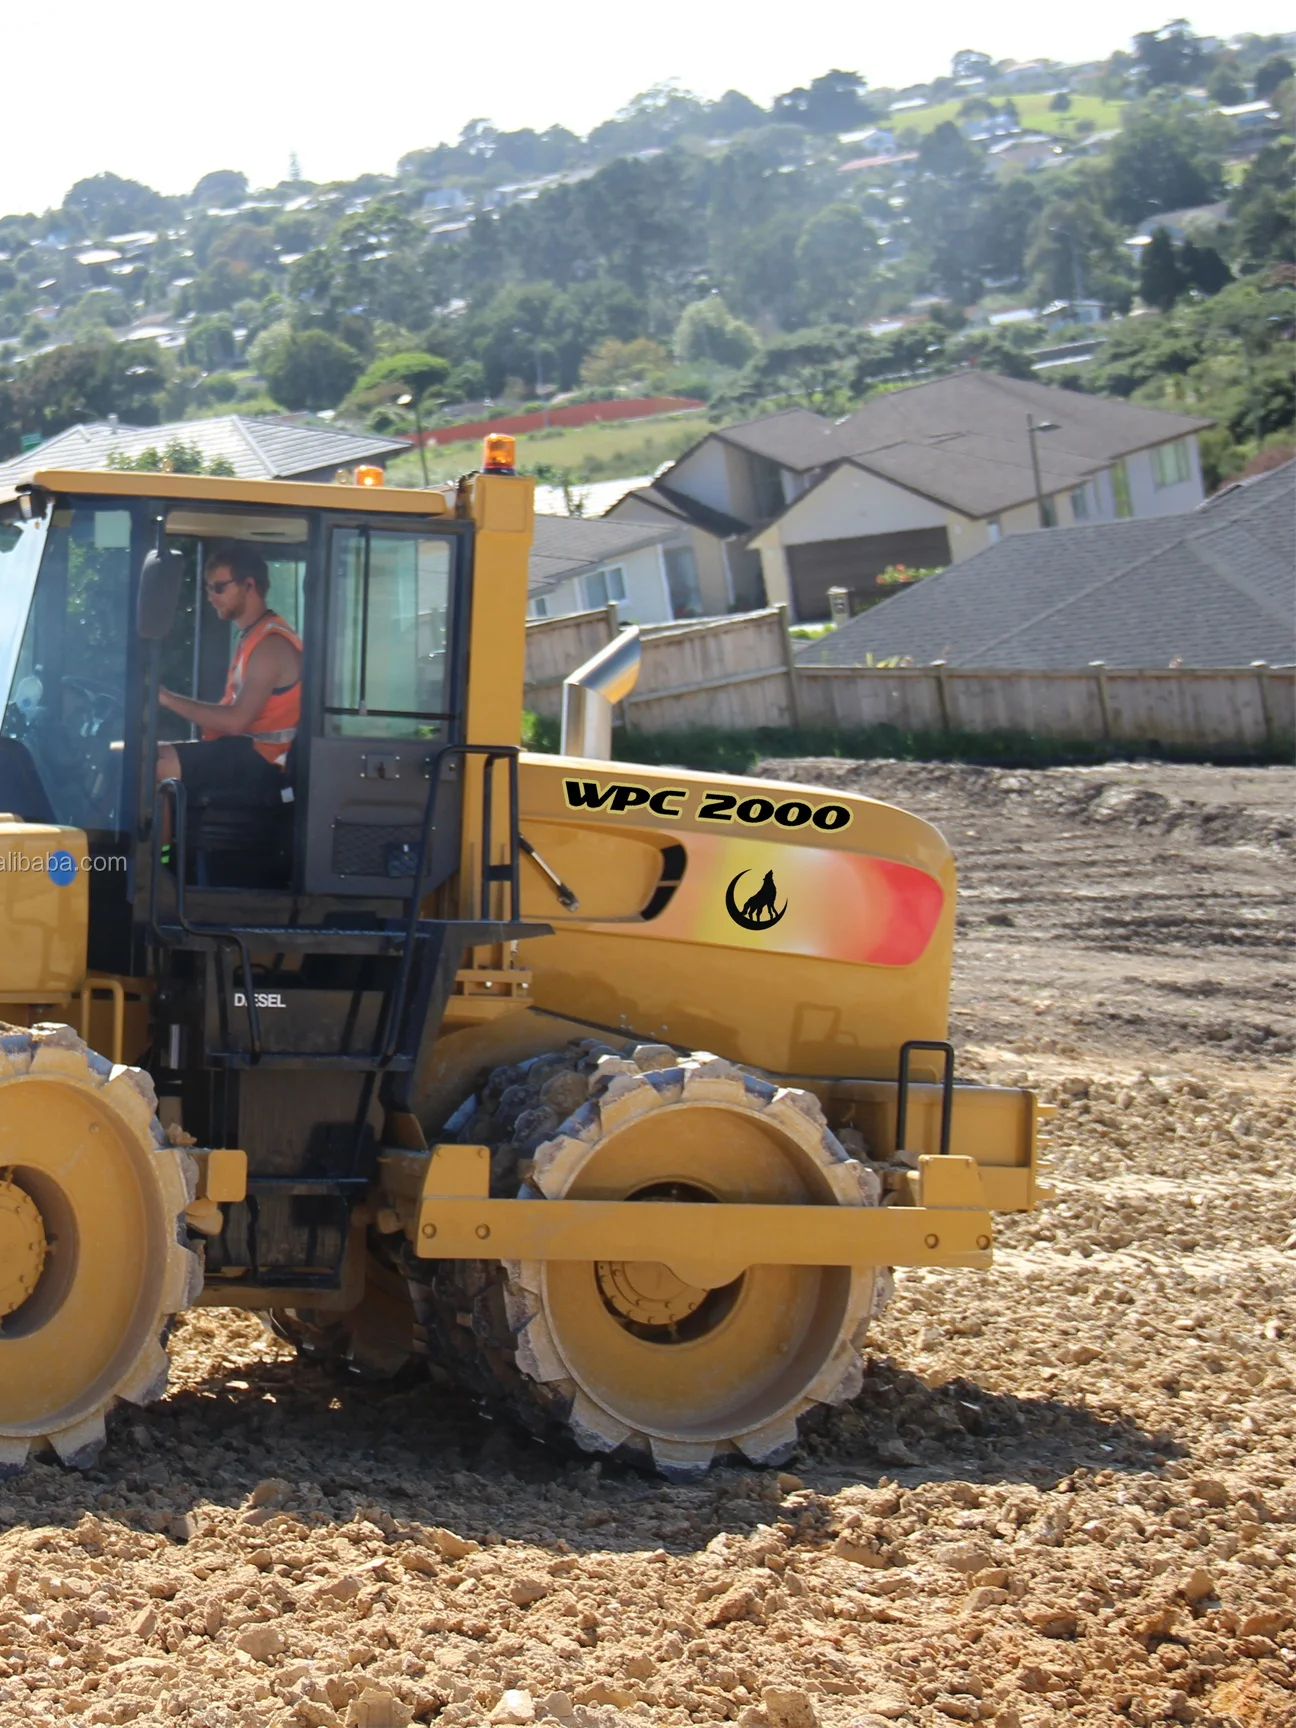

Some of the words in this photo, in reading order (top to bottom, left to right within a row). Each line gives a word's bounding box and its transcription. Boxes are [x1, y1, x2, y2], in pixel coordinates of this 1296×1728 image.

[563, 780, 687, 816] WPC
[698, 793, 851, 830] 2000
[234, 993, 286, 1007] DSEL
